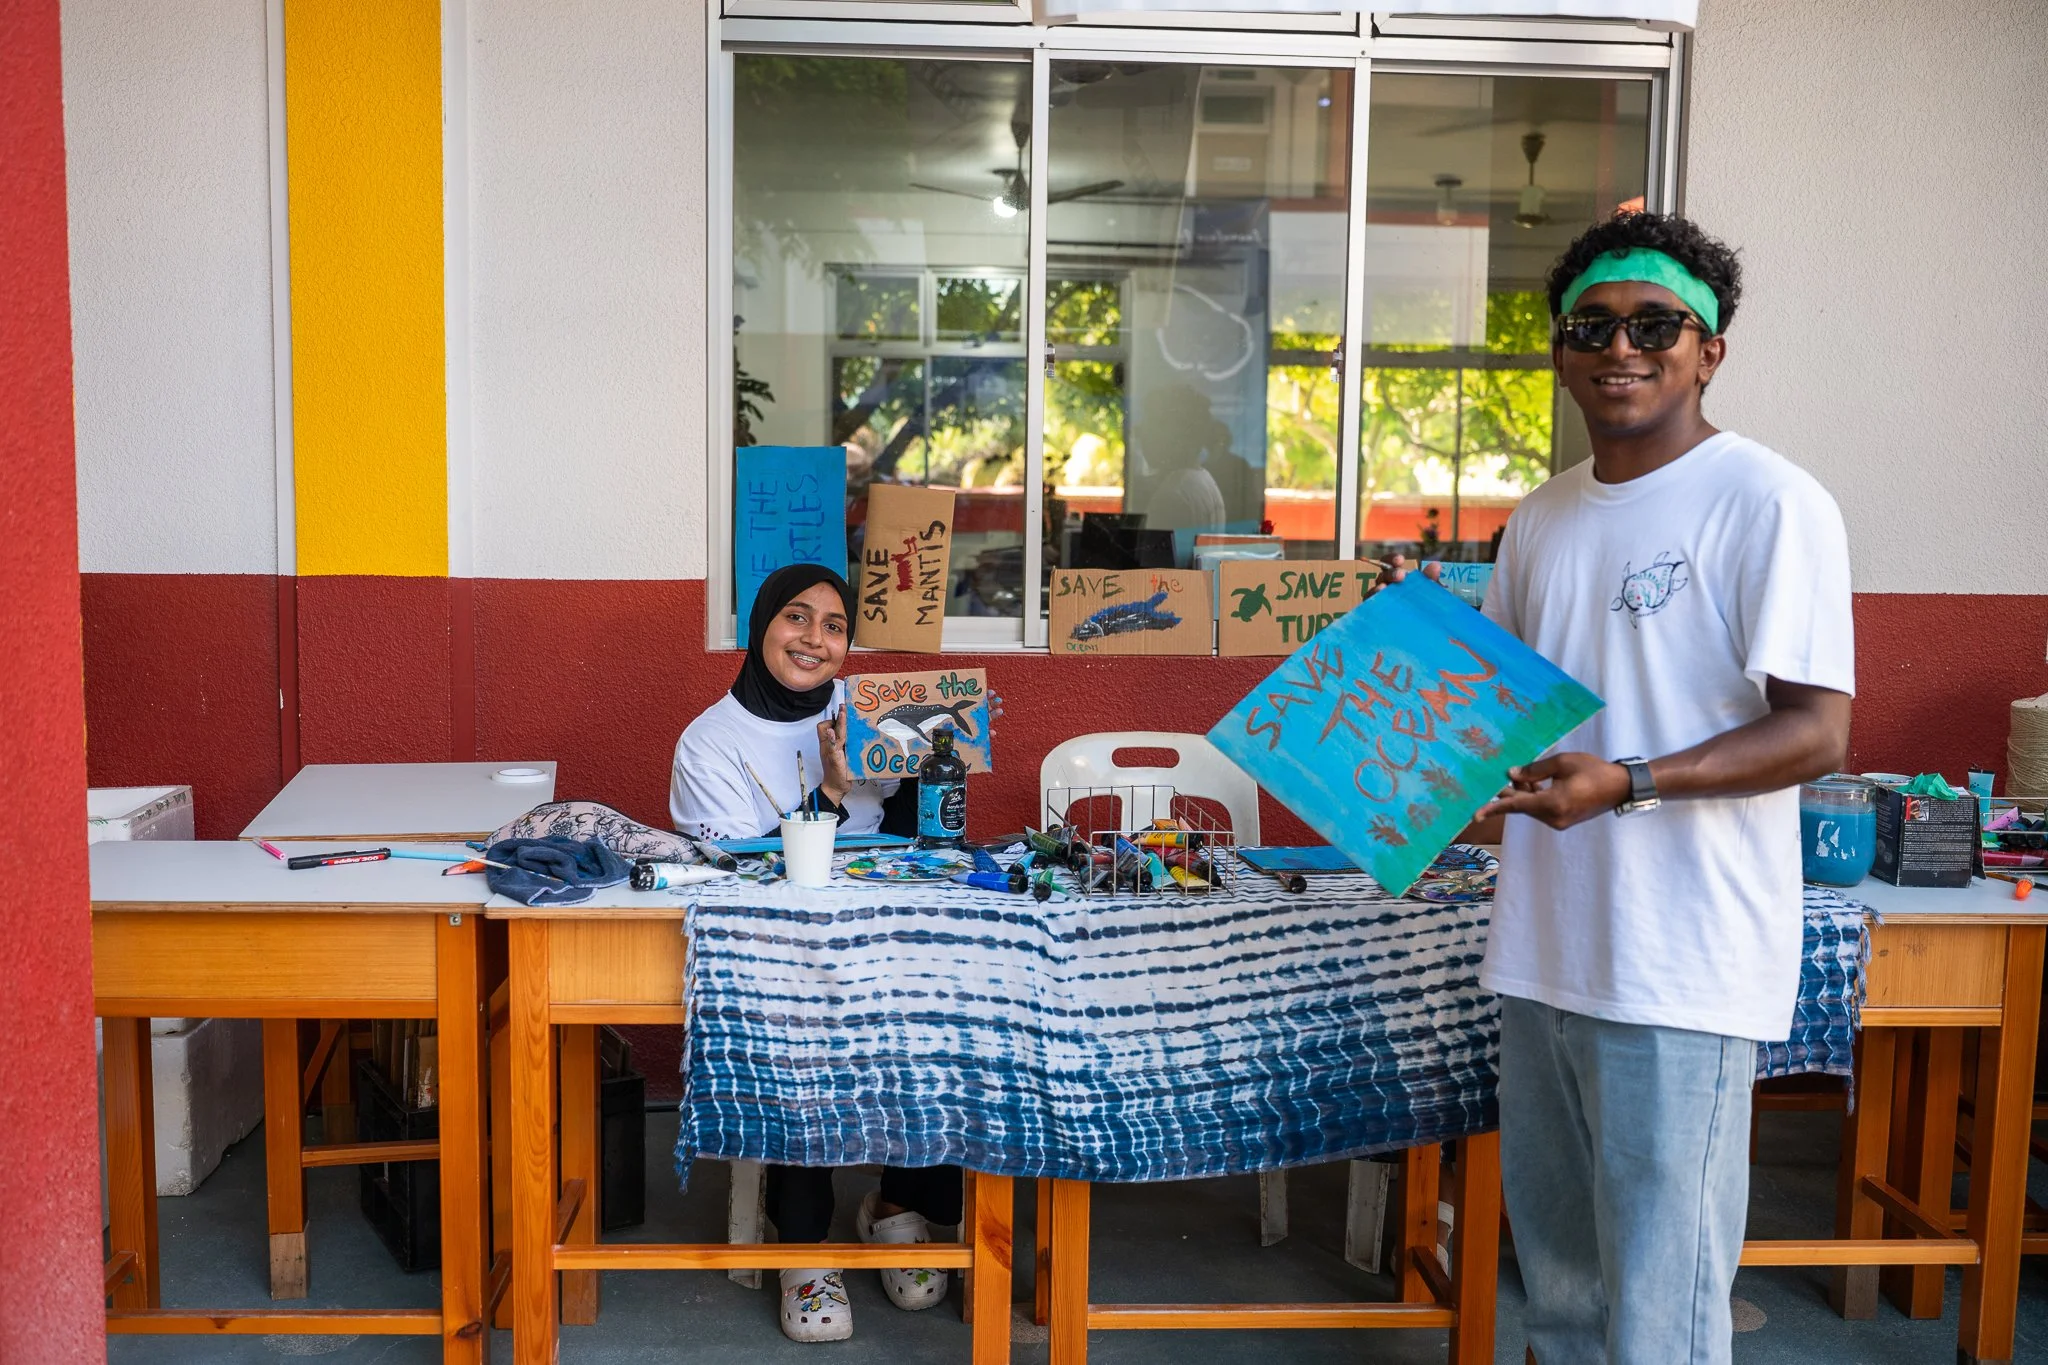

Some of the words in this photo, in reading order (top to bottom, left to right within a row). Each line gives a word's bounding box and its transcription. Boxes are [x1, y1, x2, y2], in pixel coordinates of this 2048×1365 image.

[748, 480, 777, 539] THE
[786, 473, 825, 565] RTLES
[863, 548, 891, 624] SAVE
[915, 520, 946, 625] MANTIS
[1056, 574, 1125, 600] SAVE
[1150, 574, 1184, 593] the
[1275, 571, 1345, 600] SAVE
[855, 680, 928, 712] Save
[936, 671, 982, 699] the
[1245, 642, 1345, 751] SAVE
[1318, 651, 1413, 746] THE
[1354, 637, 1498, 803] OCEAN
